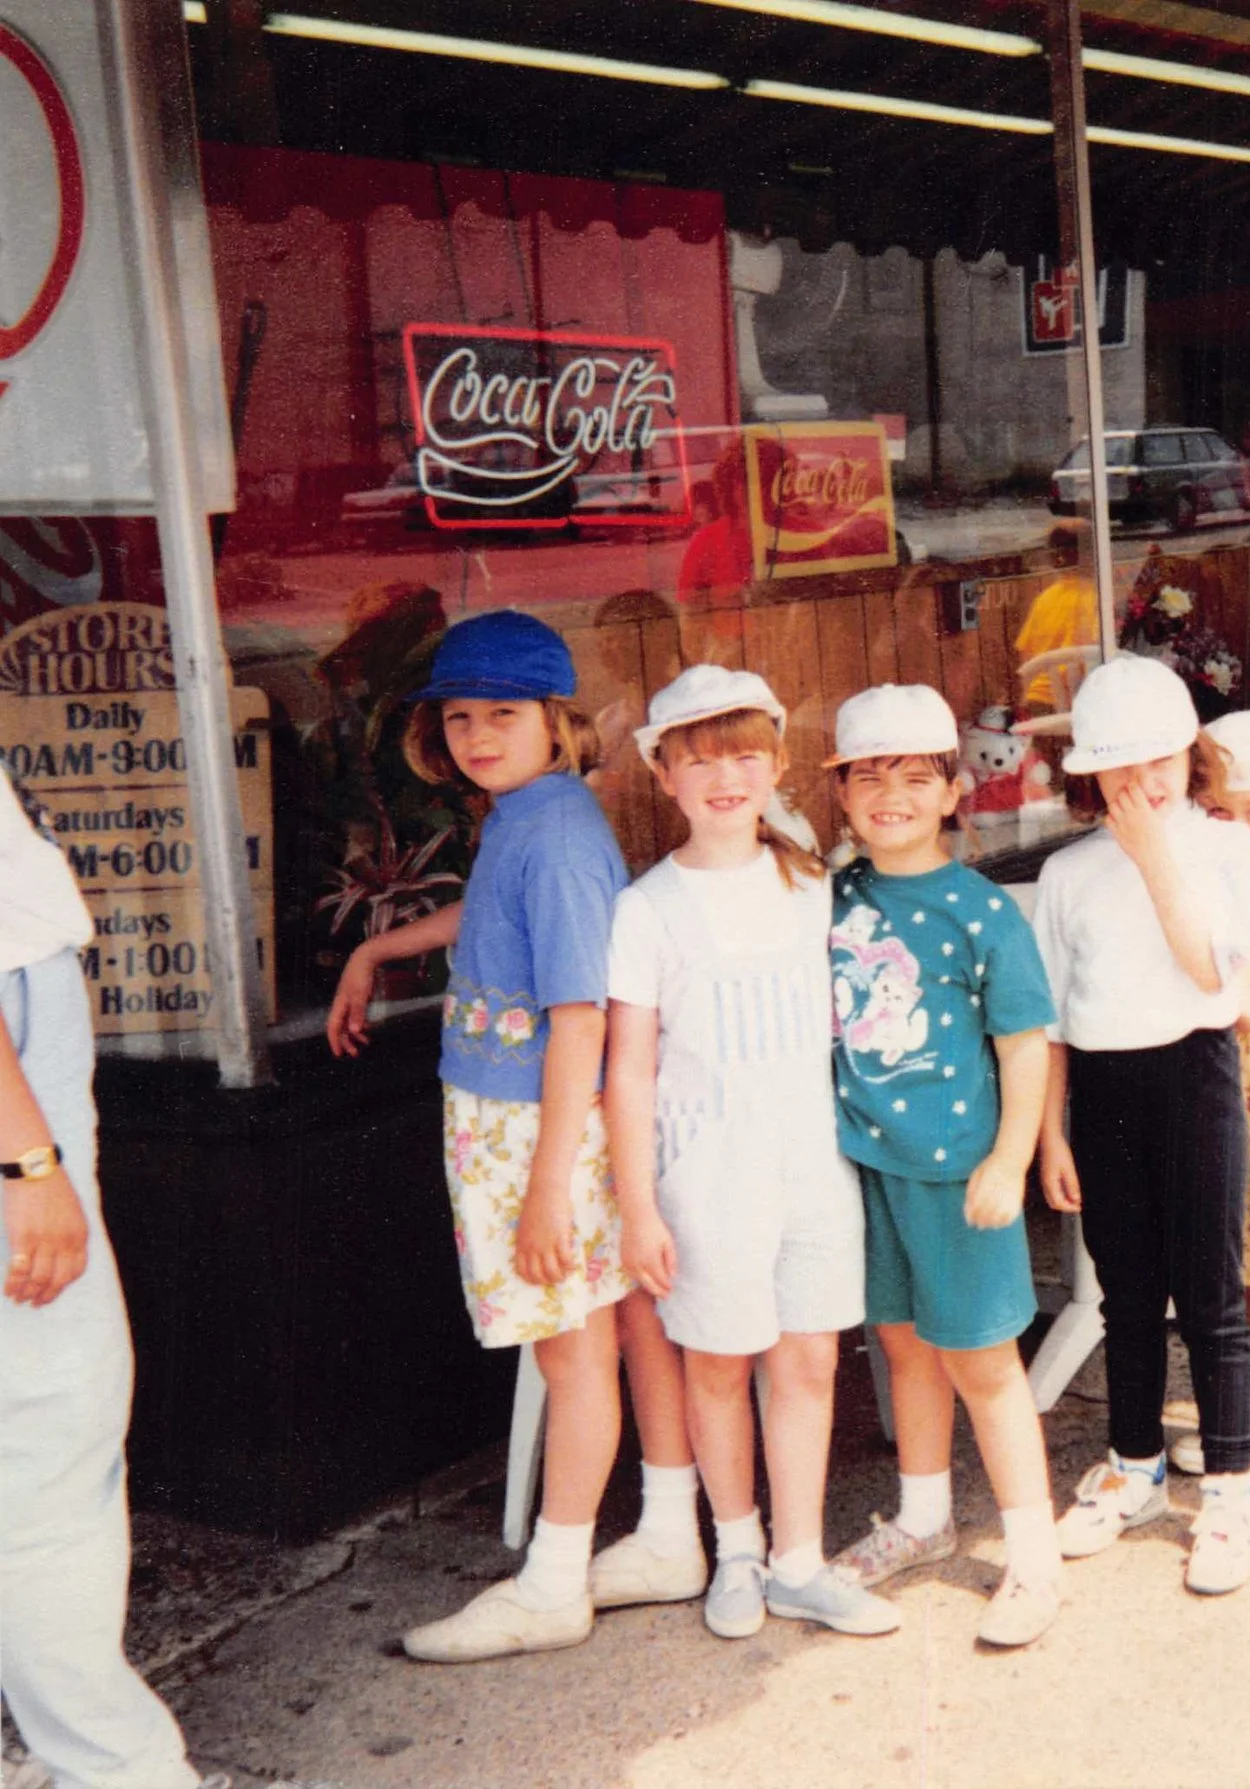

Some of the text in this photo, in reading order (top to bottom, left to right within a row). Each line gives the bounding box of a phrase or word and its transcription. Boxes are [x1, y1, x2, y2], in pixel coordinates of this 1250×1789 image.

[28, 611, 171, 652] STORE
[27, 651, 176, 695] HOURS
[66, 702, 145, 736] Daily
